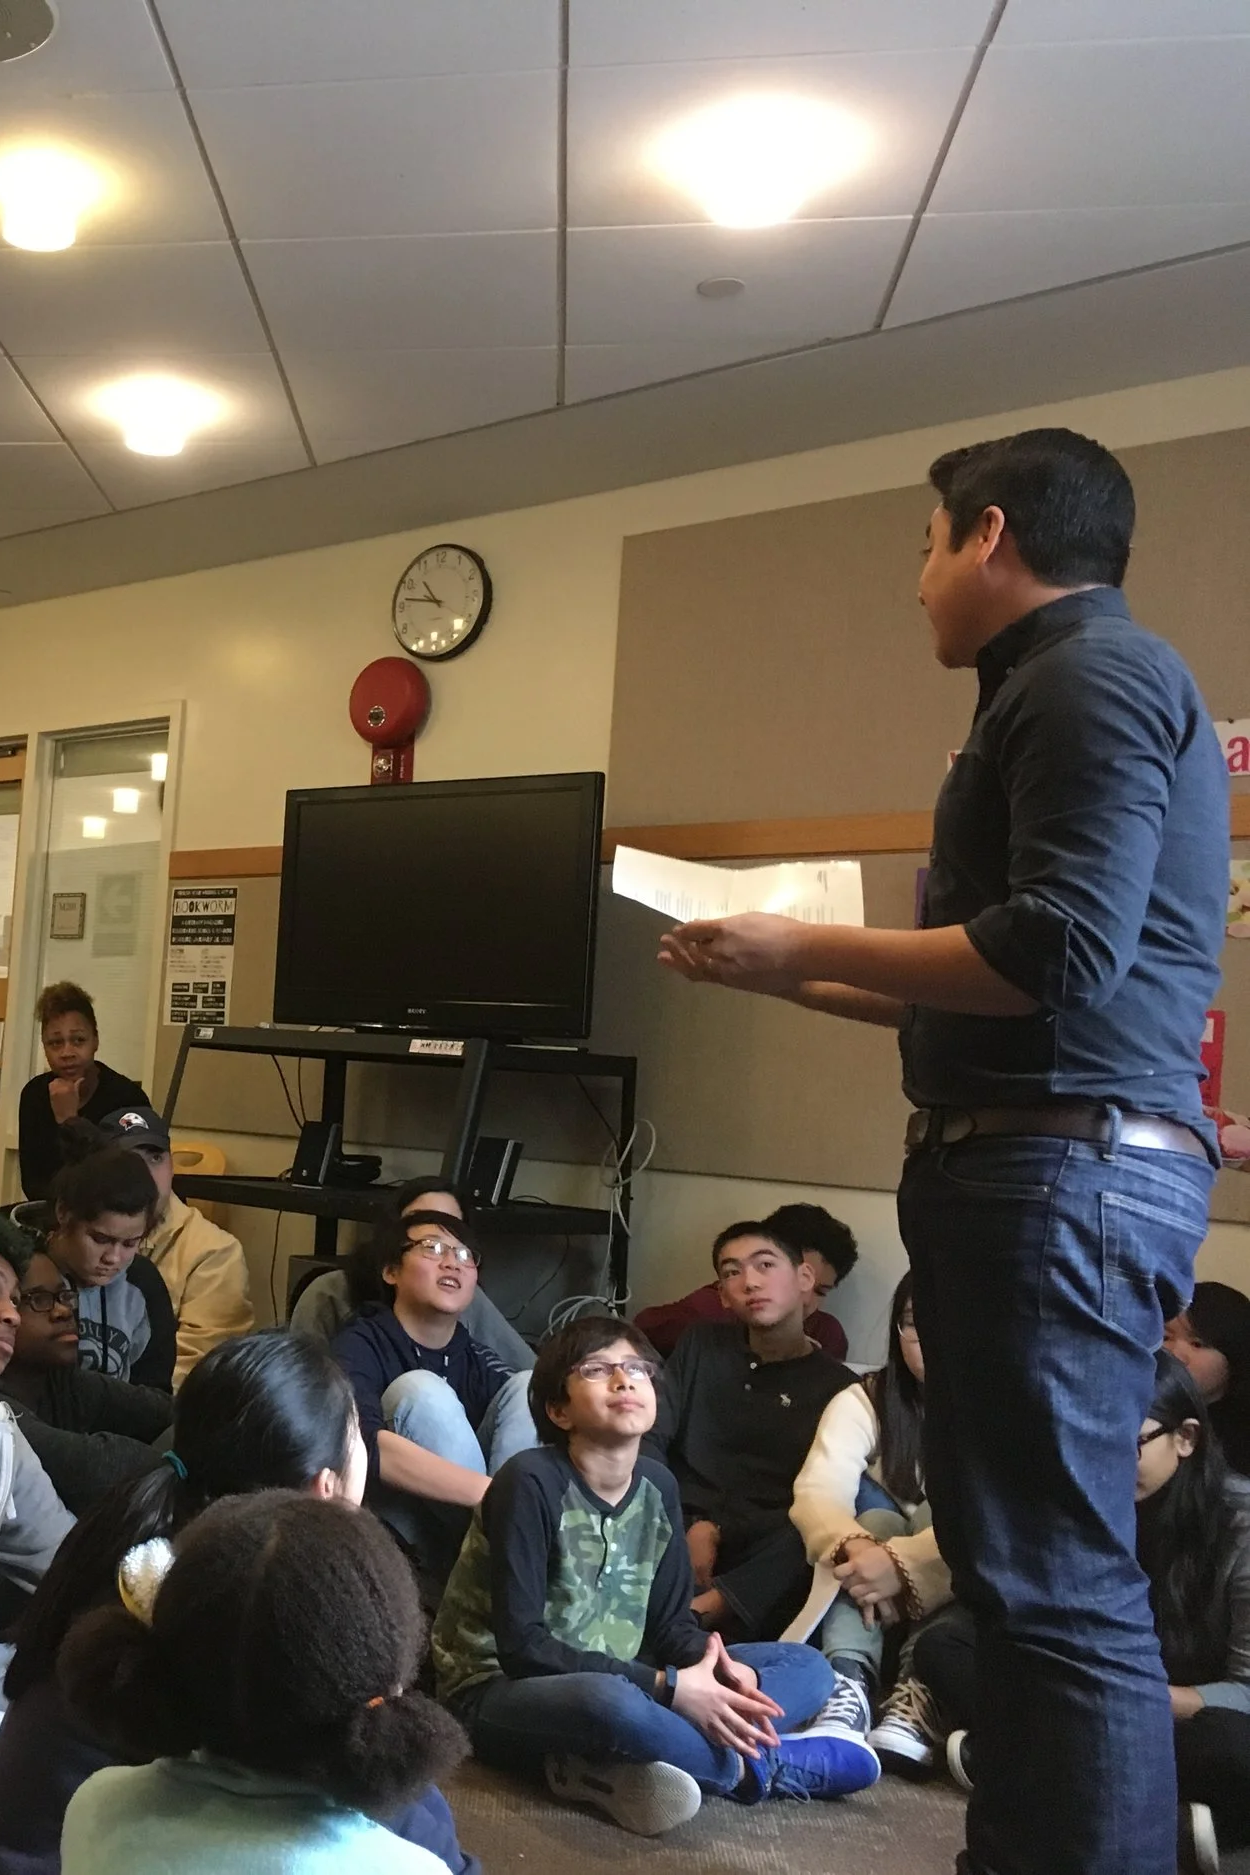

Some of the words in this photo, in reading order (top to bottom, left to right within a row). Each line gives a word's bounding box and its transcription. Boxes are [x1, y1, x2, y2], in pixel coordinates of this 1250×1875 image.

[436, 551, 447, 563] 12
[458, 555, 462, 566] 1
[417, 560, 427, 571] 11
[403, 579, 414, 590] 10
[399, 602, 405, 613] 9
[402, 623, 408, 635] 8
[175, 900, 233, 913] BOOKWORM
